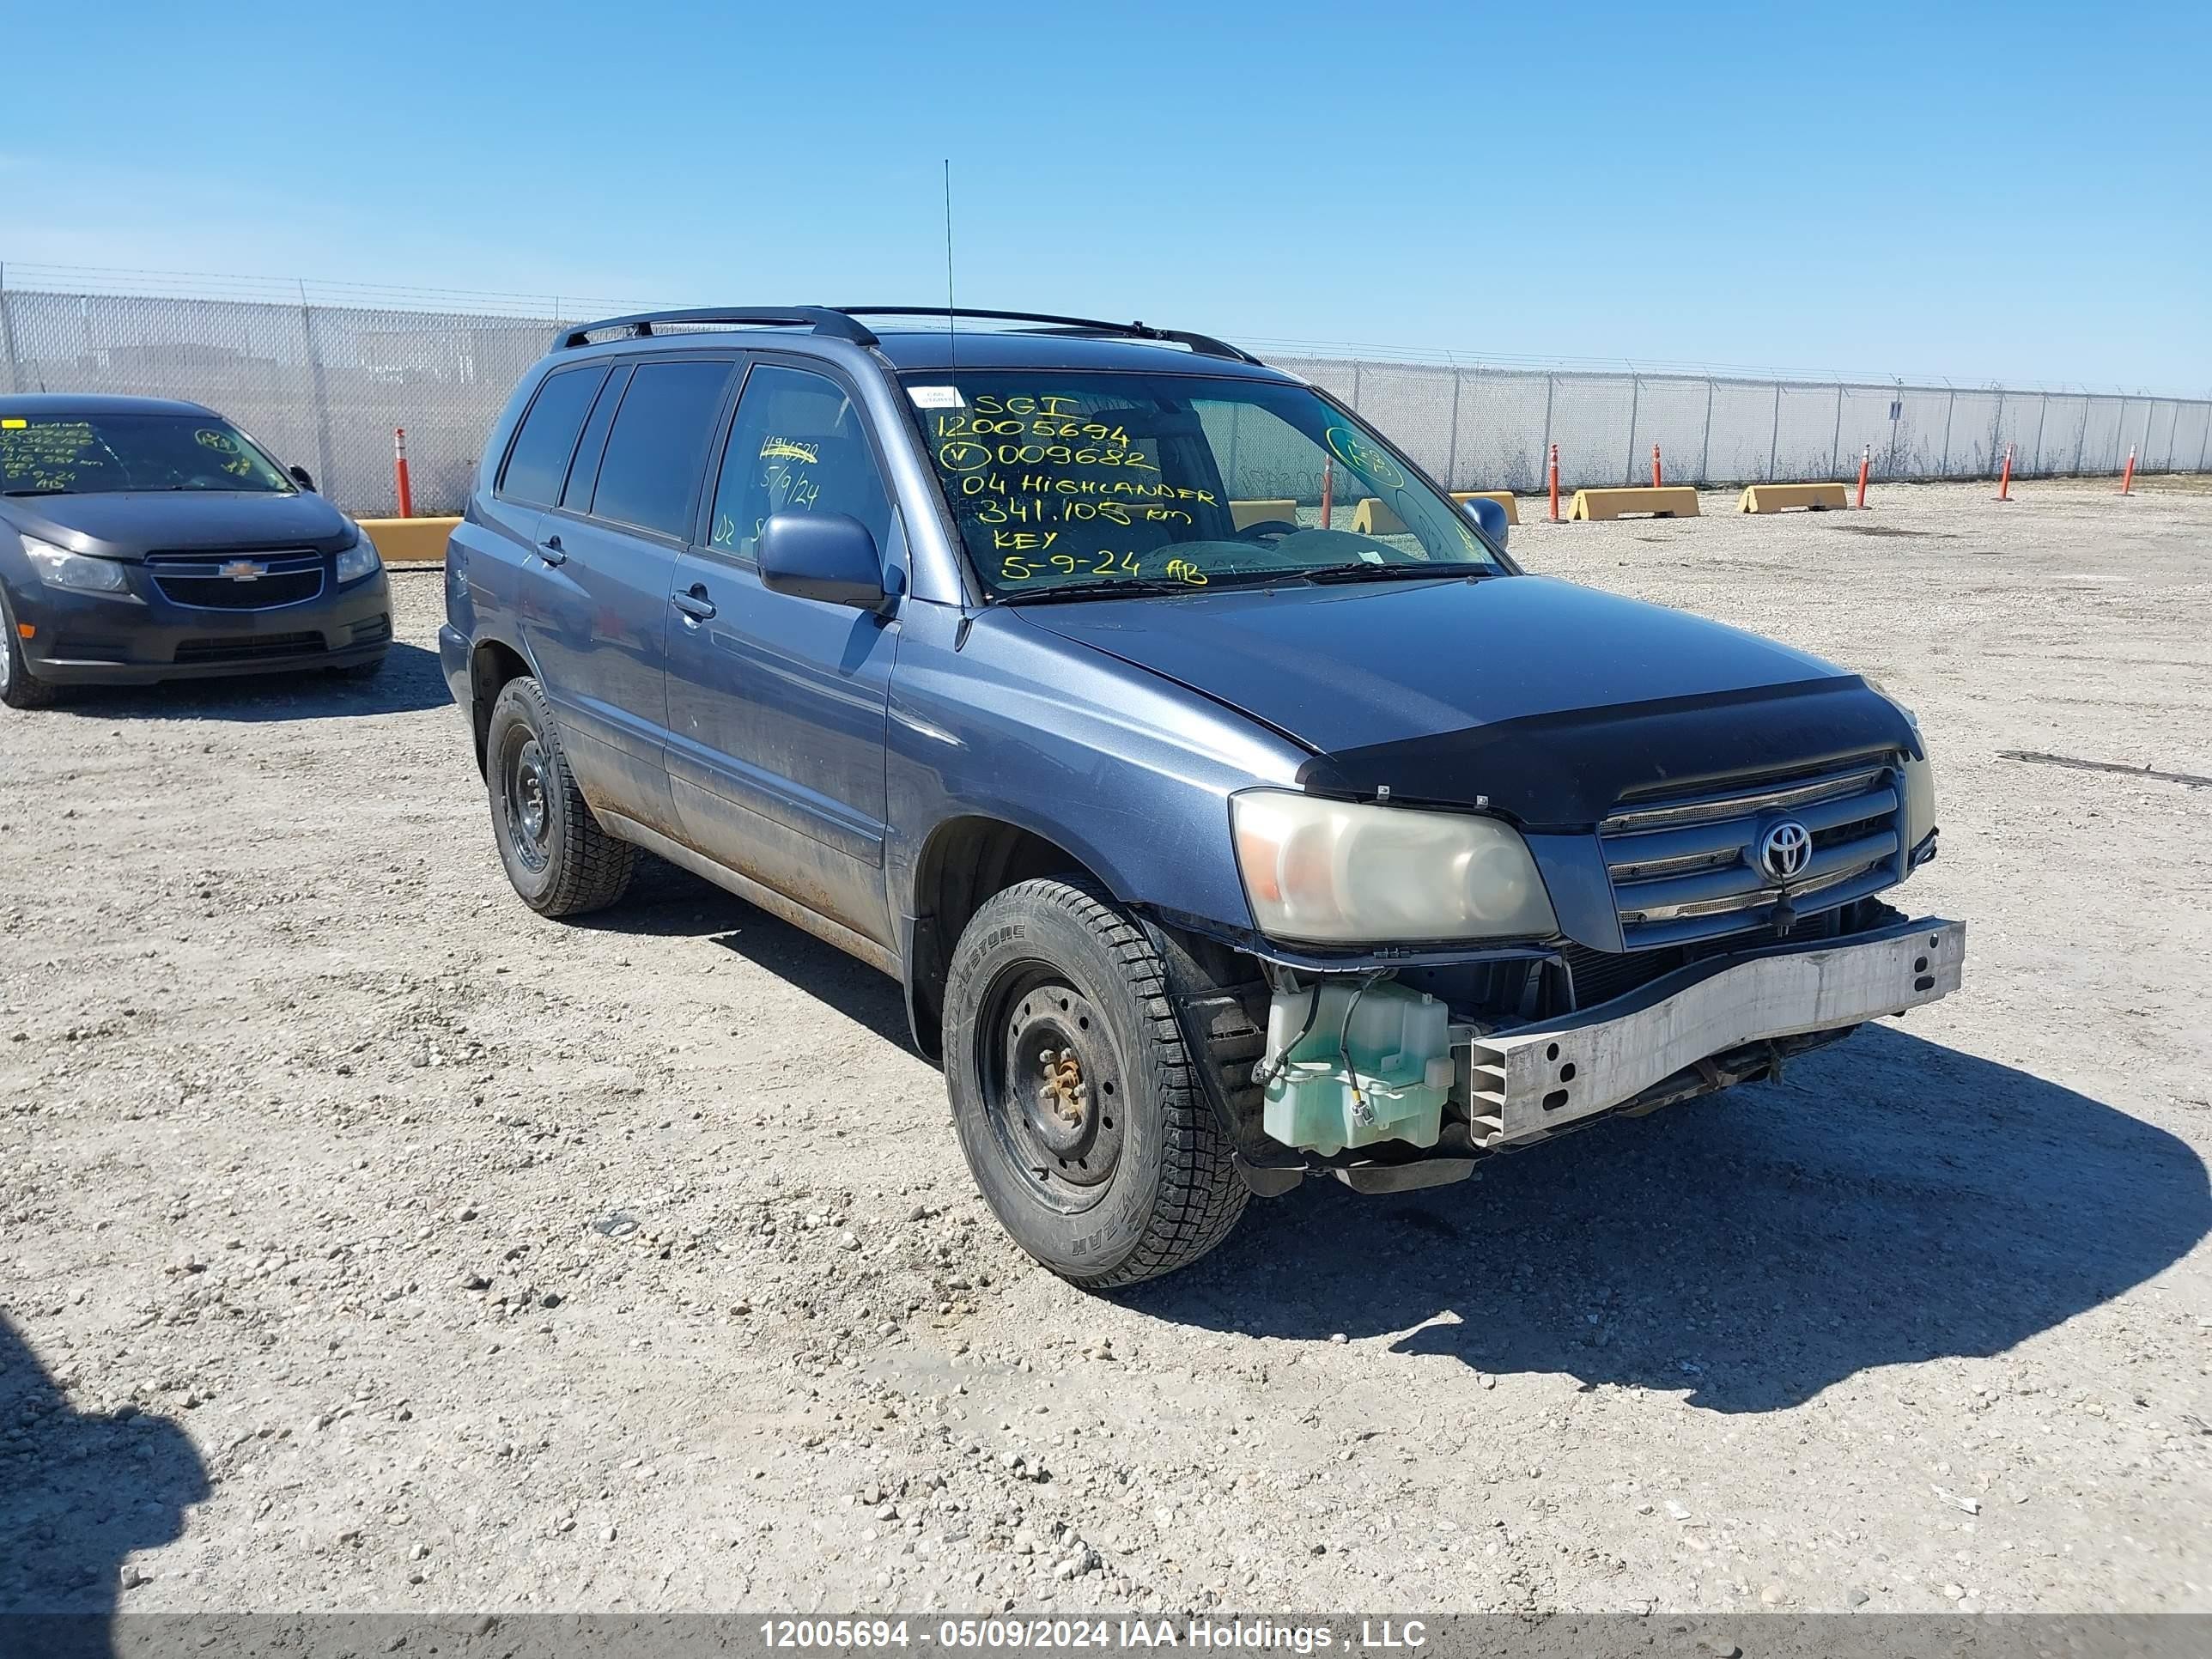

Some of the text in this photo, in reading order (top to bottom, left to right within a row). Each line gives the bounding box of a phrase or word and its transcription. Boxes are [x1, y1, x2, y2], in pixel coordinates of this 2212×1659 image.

[975, 396, 1087, 420] SGI
[939, 416, 1131, 448] 12005694
[998, 445, 1161, 471] 009682
[760, 465, 820, 511] 5/9/24
[963, 475, 1005, 495] 04
[994, 530, 1059, 550] KEY
[1002, 550, 1140, 580] 5-9-24
